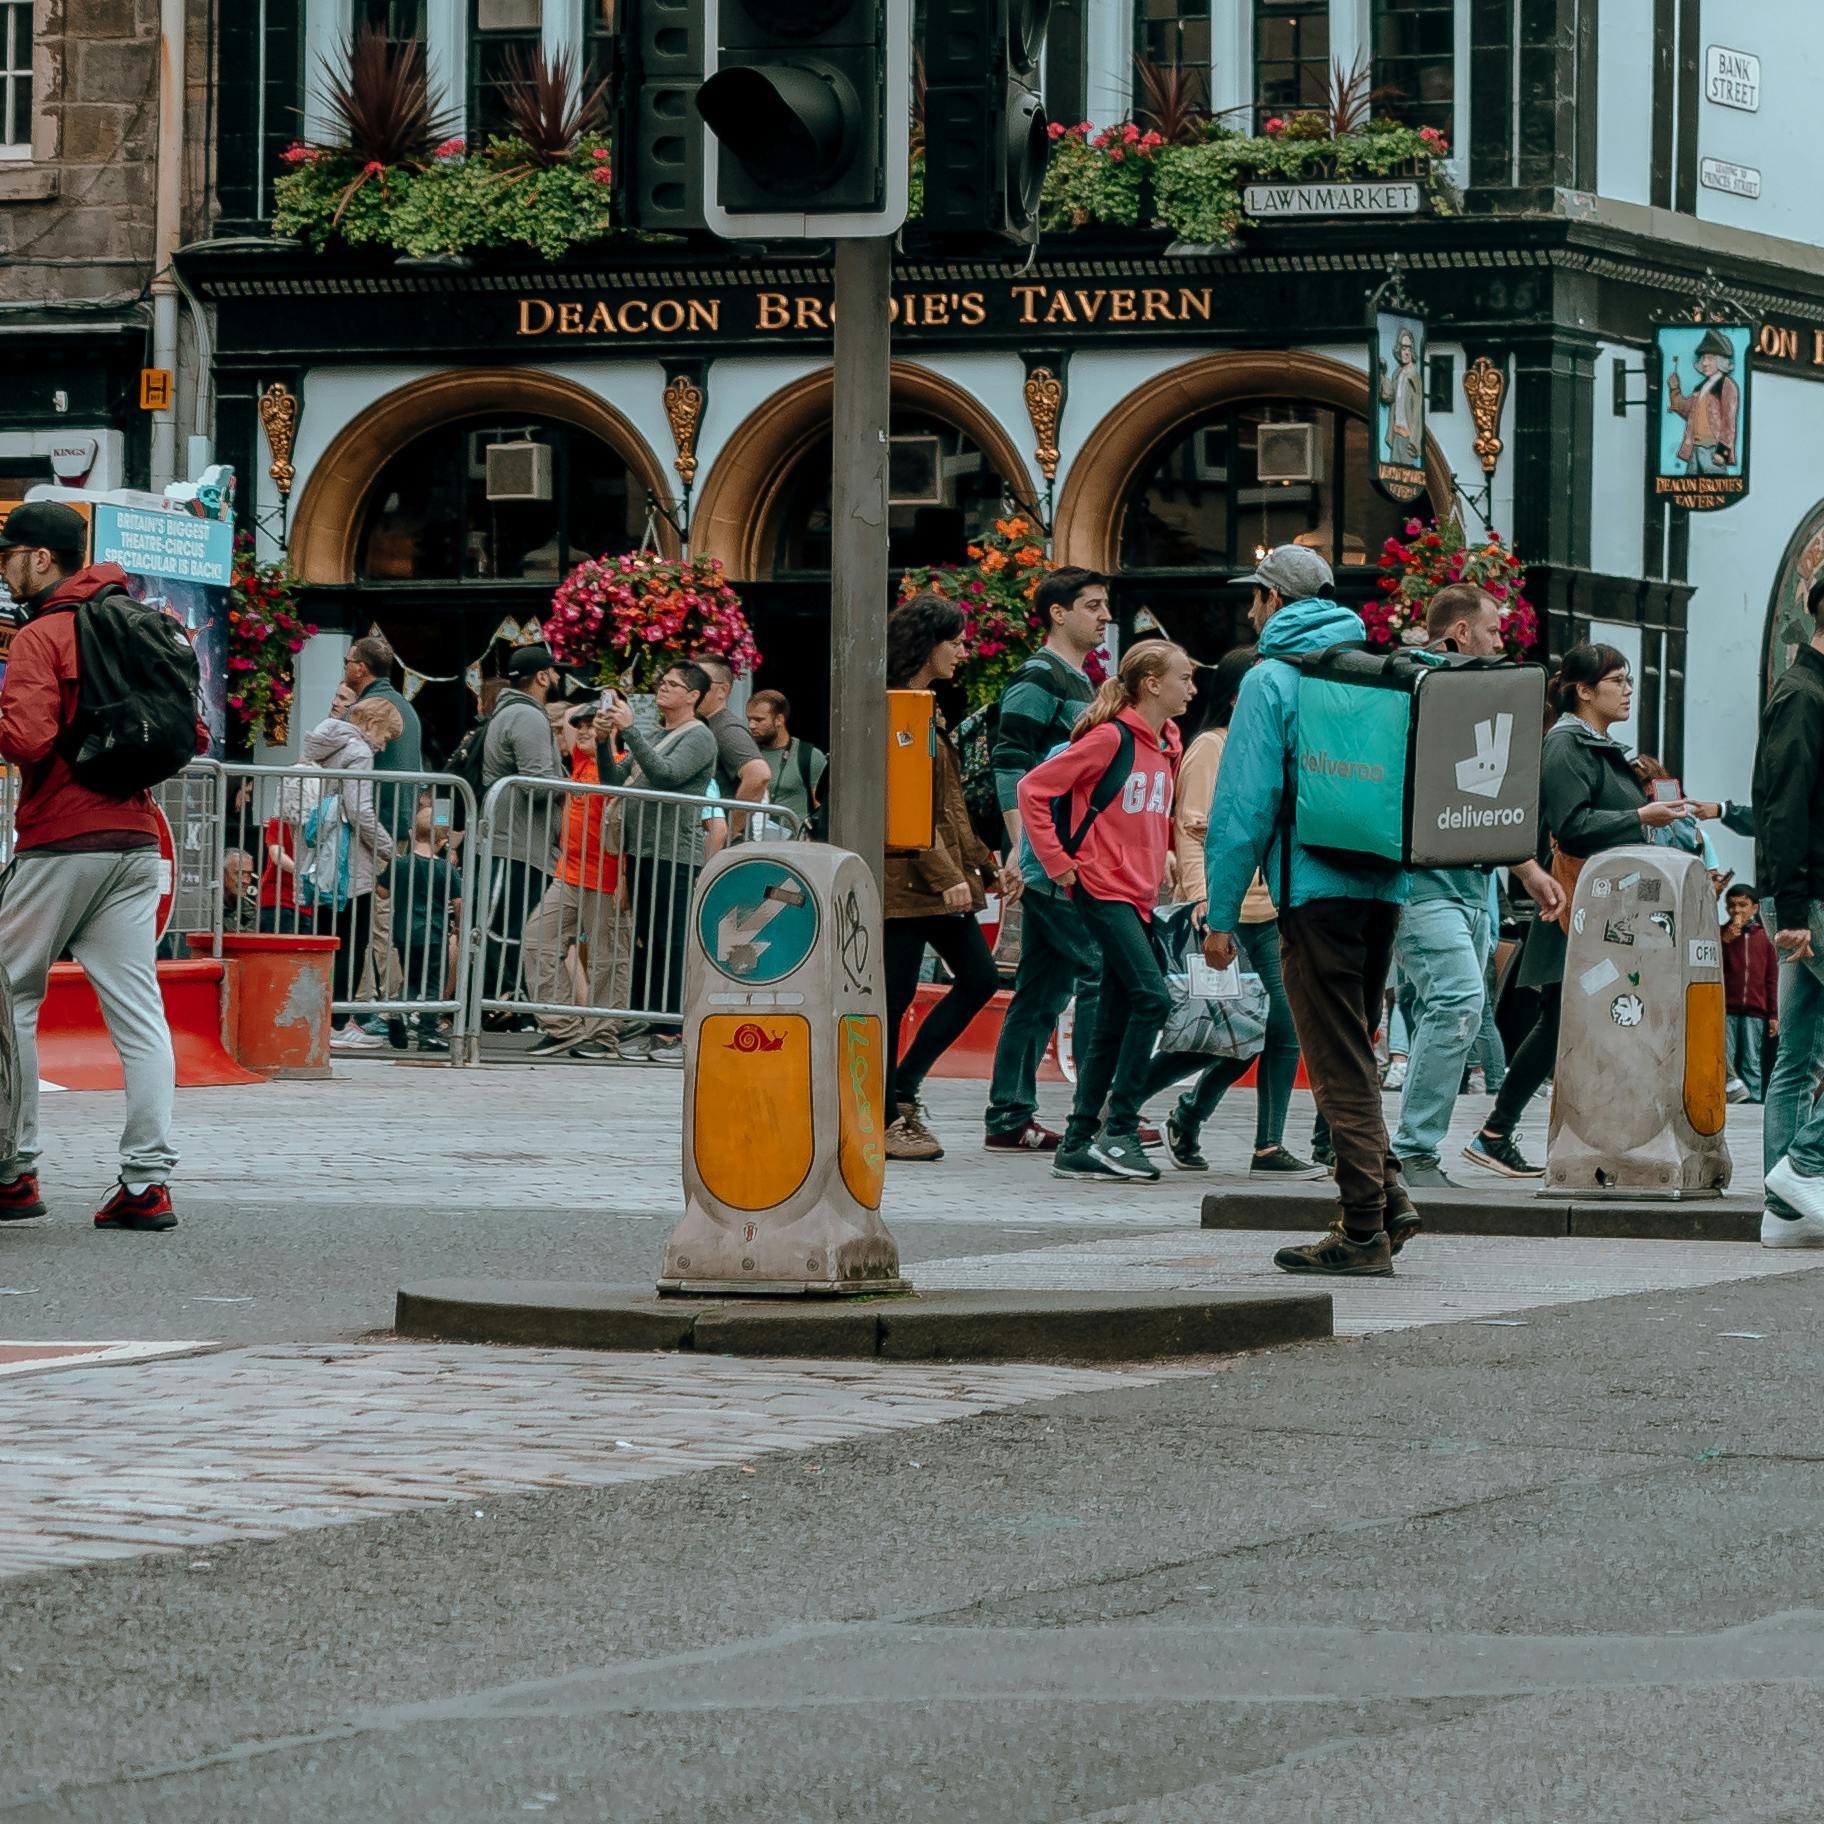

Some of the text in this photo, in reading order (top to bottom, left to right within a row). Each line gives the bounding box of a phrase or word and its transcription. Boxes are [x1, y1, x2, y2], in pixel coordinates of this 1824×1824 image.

[1719, 54, 1750, 81] BANK
[1712, 77, 1756, 106] STREET
[1703, 171, 1758, 195] PRINCES STREET
[1250, 186, 1413, 211] LAWNMARKET
[516, 297, 721, 335] DEACON
[1011, 285, 1213, 323] TAVERN
[53, 448, 86, 457] KINGS
[1656, 477, 1697, 493] DEACON
[1673, 495, 1725, 508] TAVERN
[117, 511, 209, 540] BRITAIN'S BIGGEST
[120, 531, 205, 558] THEATRE-CIRCUS
[104, 548, 223, 579] SPECTACULAR IS BACK!
[1437, 804, 1525, 830] deliveroo
